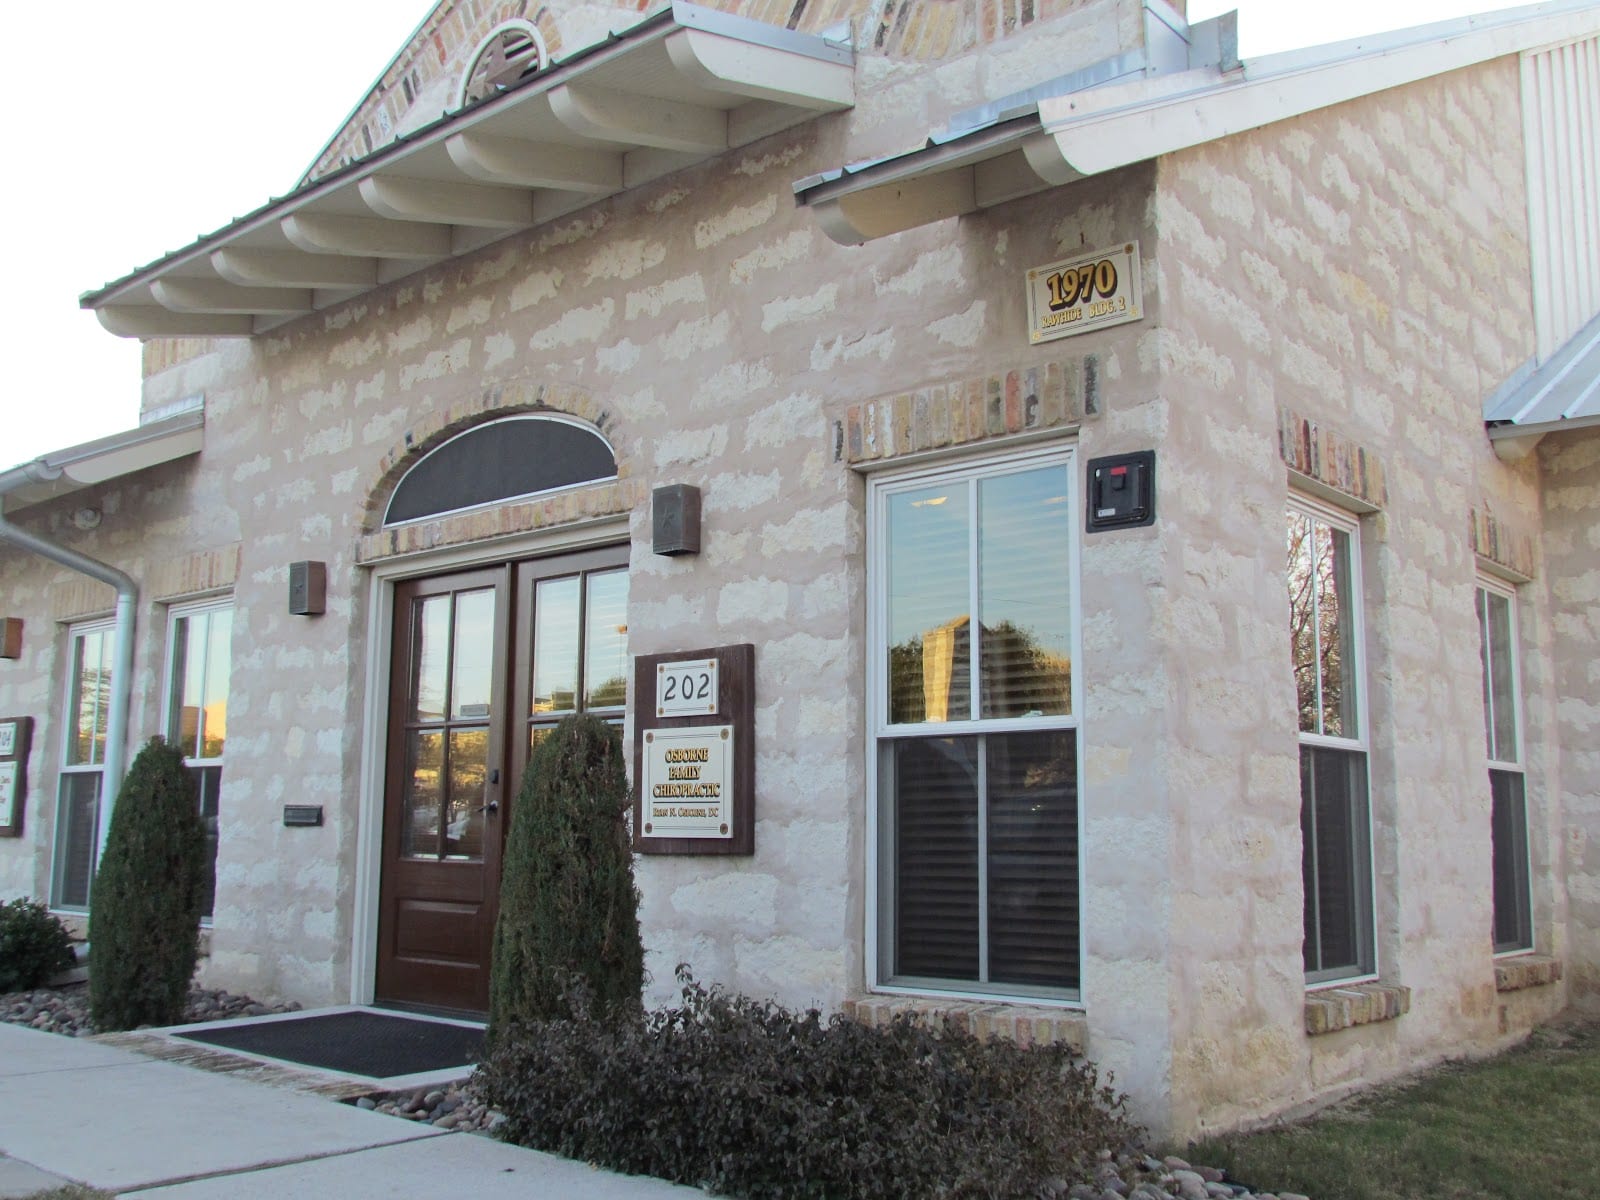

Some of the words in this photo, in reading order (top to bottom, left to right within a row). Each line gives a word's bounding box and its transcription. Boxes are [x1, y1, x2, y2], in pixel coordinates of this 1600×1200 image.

[1047, 259, 1118, 312] 1970
[1041, 308, 1082, 328] RAWHIDE
[1089, 300, 1116, 319] BLDG.
[1119, 296, 1126, 311] 2
[664, 673, 710, 701] 202
[665, 747, 708, 763] OSBORNE
[668, 766, 701, 780] FAMILY
[653, 783, 720, 798] CHIROPRACTIC
